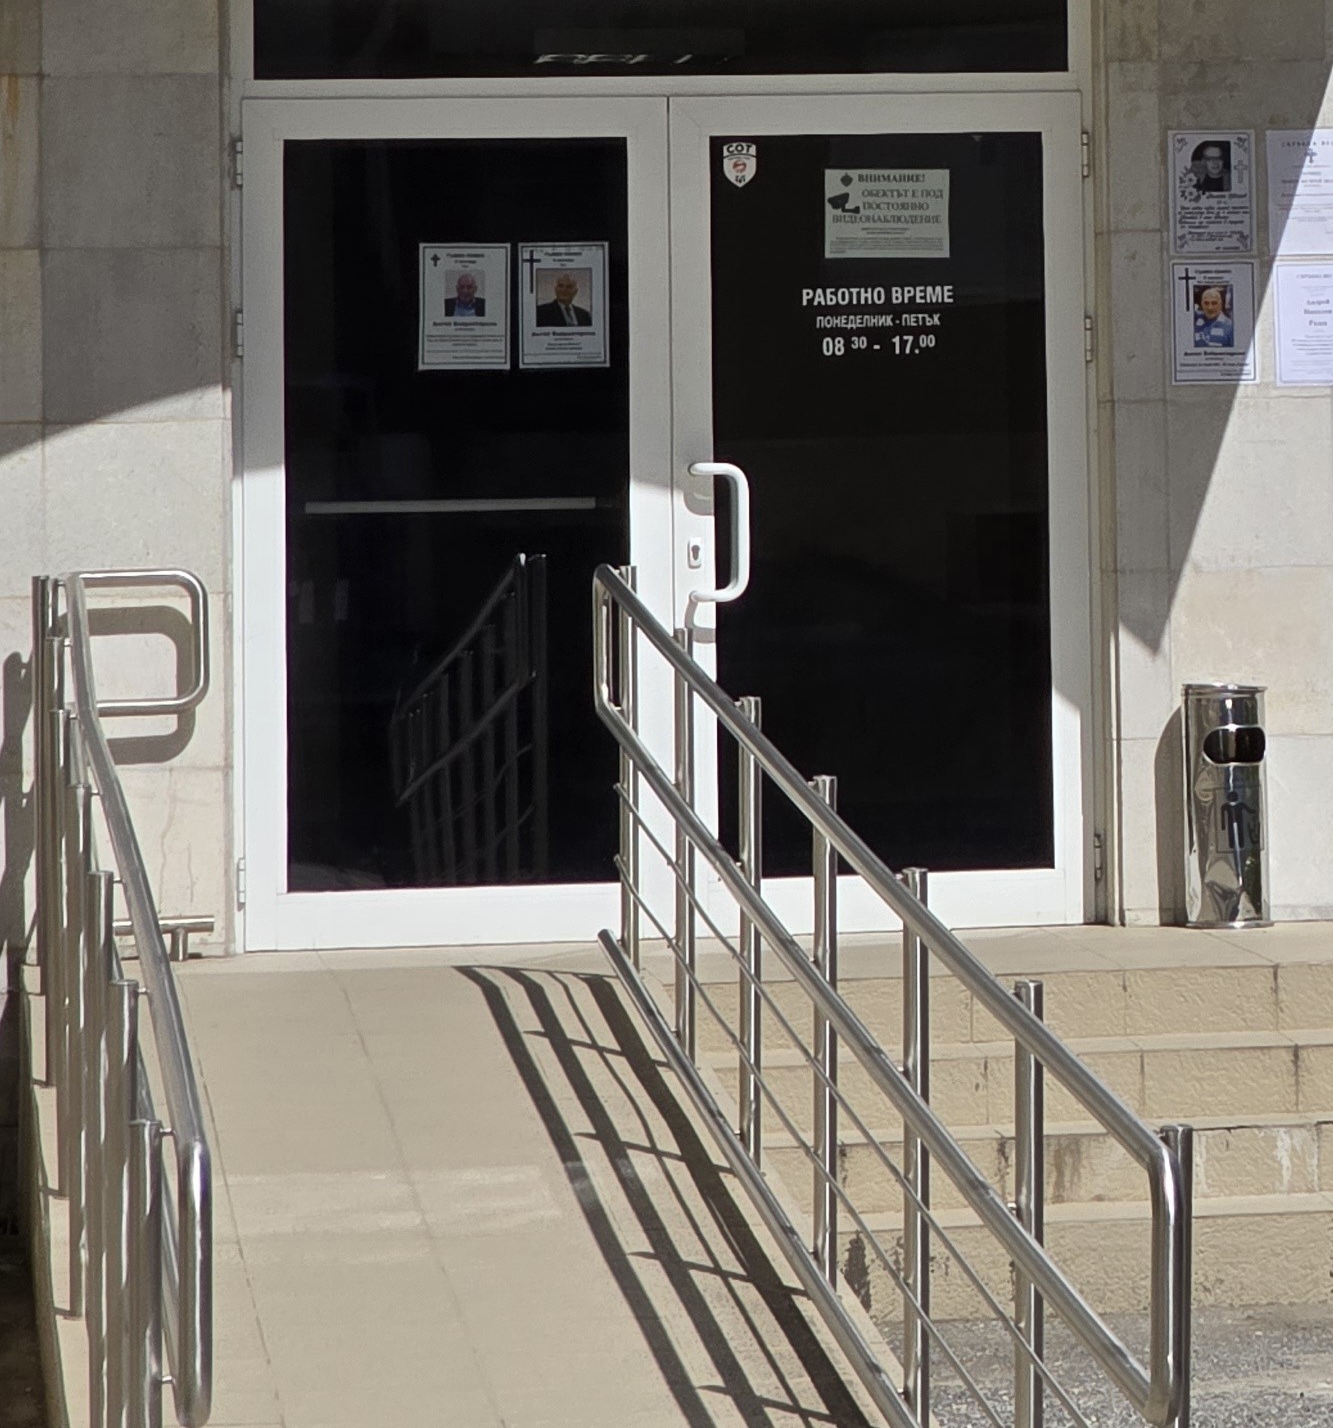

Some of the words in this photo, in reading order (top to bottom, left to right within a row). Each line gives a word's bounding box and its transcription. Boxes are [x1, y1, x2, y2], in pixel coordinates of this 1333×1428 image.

[726, 143, 753, 154] СОТ
[802, 286, 886, 307] РАБОТНО
[891, 285, 955, 304] ВРЕМЕ
[816, 314, 894, 330] ПОНЕДЕЛНИК
[901, 313, 941, 327] ПЕТЪК
[822, 336, 845, 357] 08
[851, 336, 868, 350] 30
